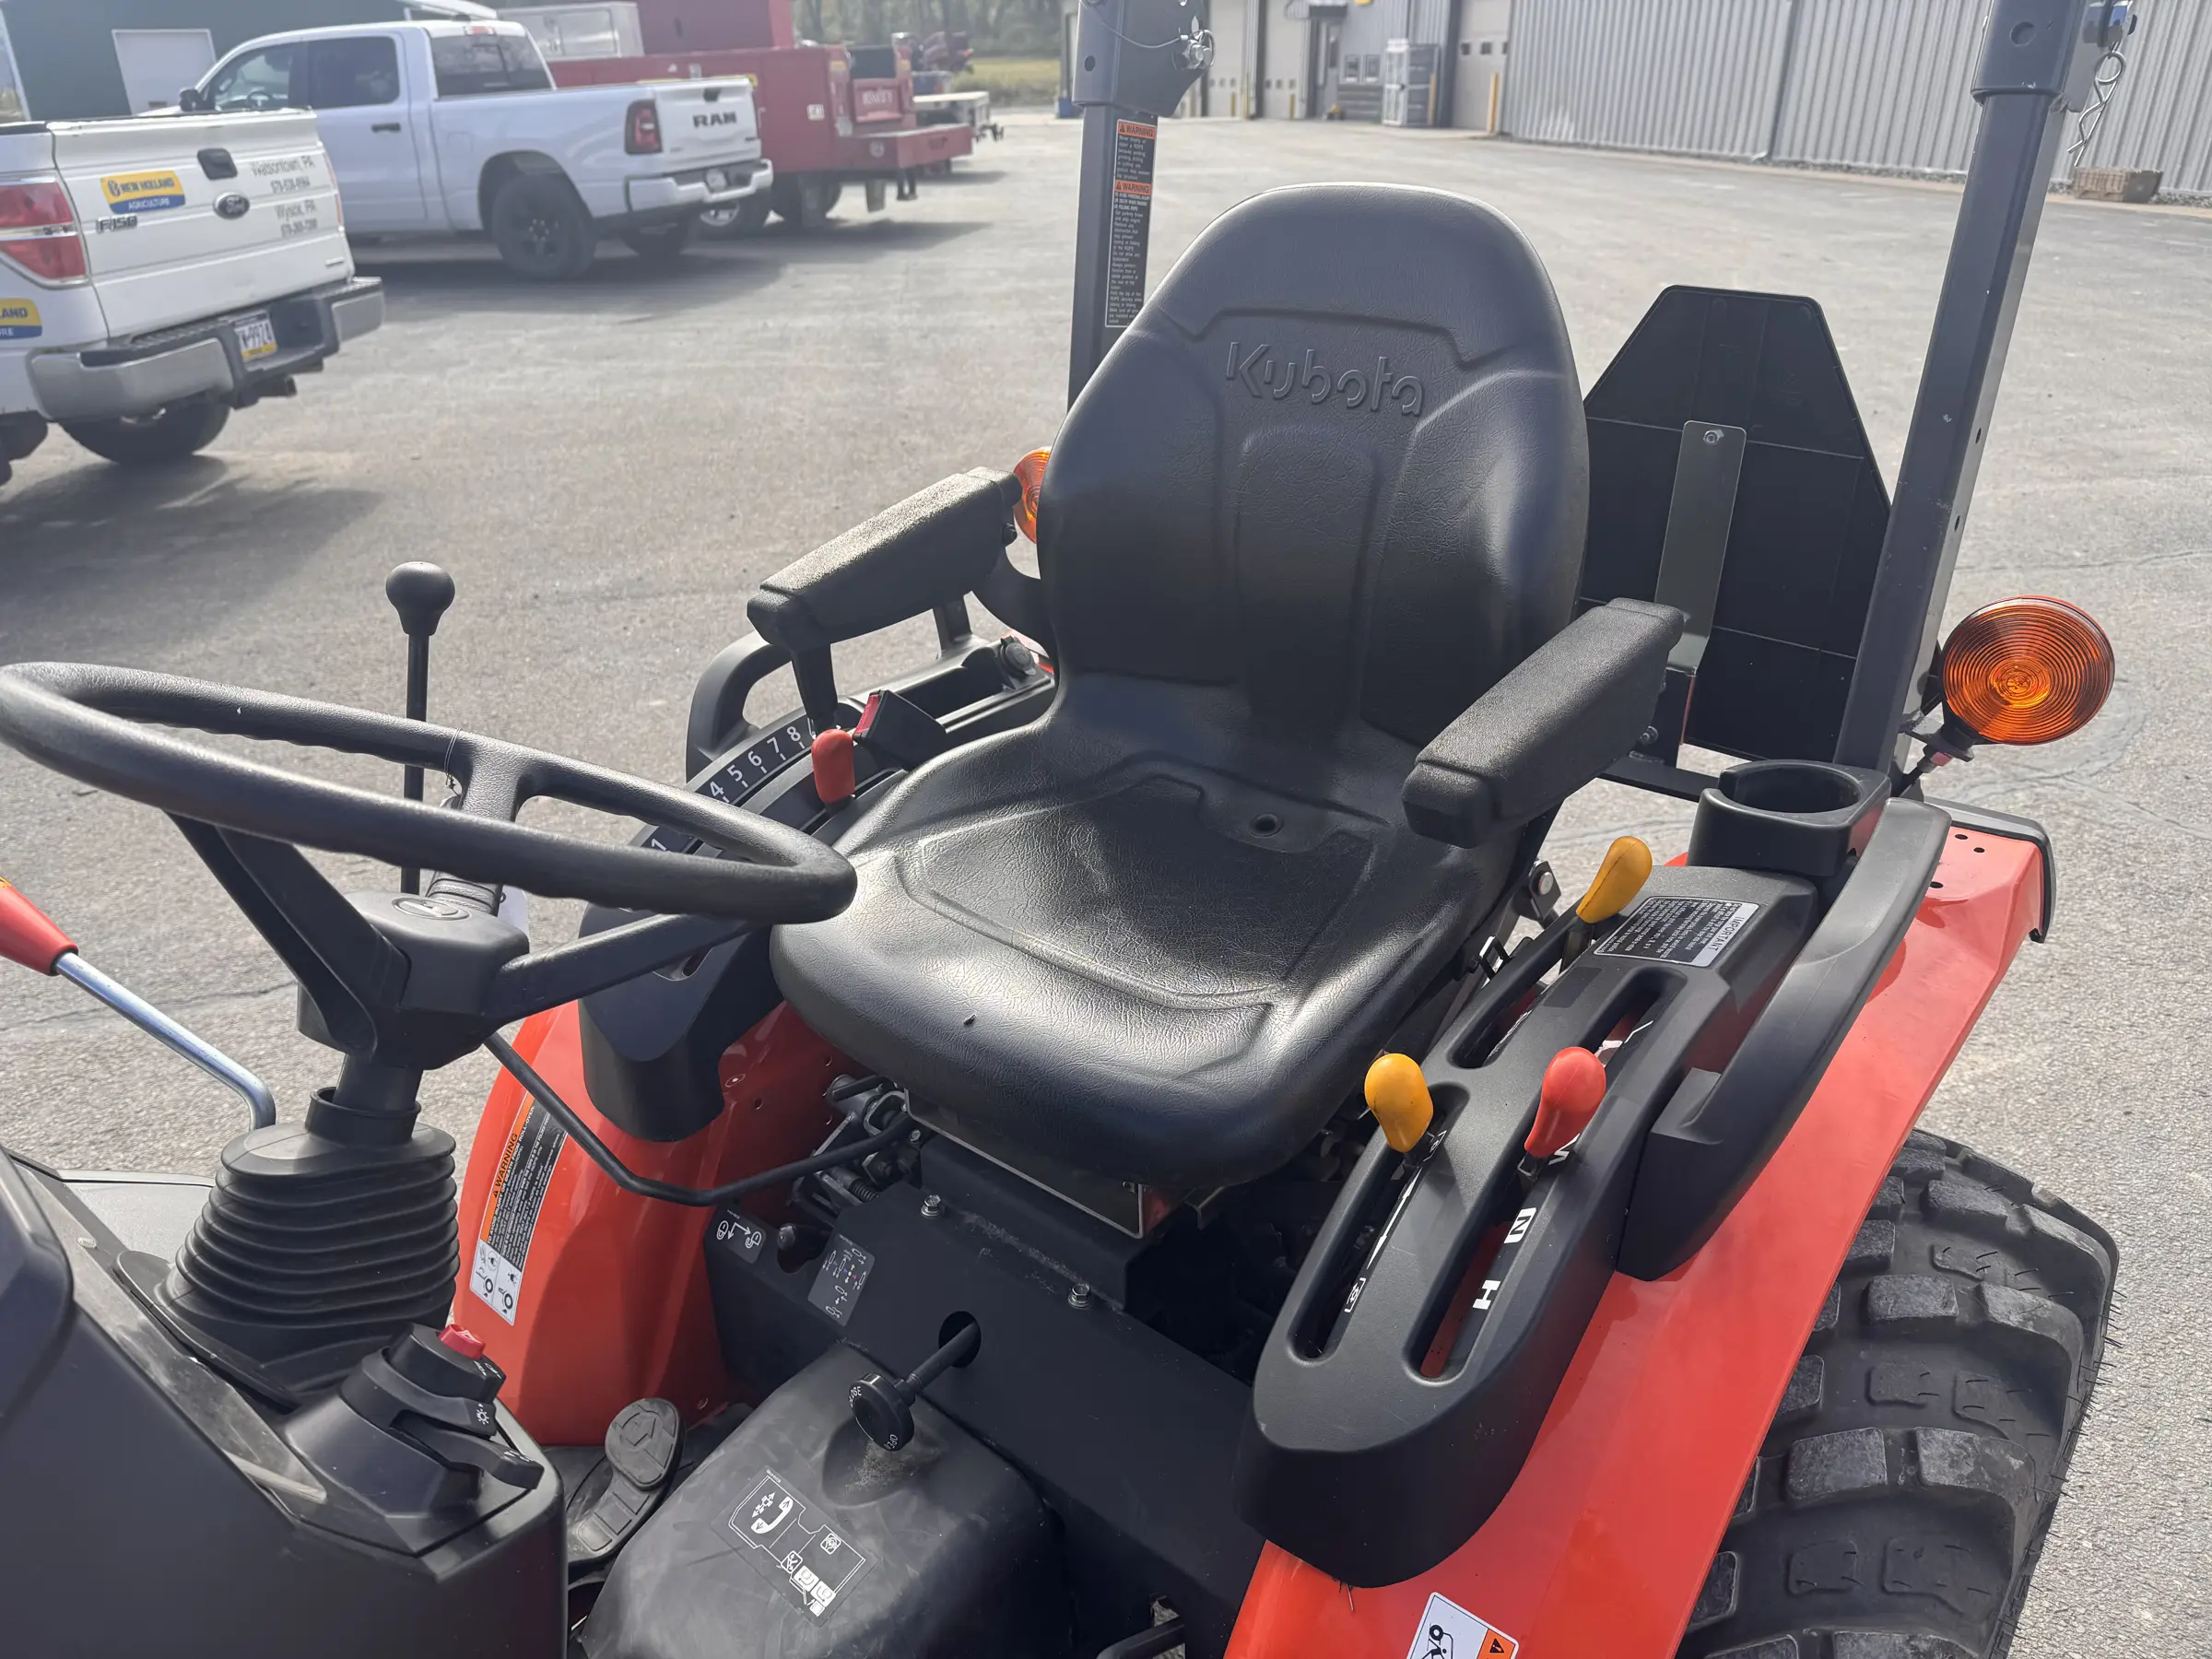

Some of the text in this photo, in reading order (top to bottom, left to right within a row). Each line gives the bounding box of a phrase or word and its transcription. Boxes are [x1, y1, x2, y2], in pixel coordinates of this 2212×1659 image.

[693, 111, 736, 128] RAM
[1126, 125, 1154, 137] WARNING
[1122, 182, 1150, 194] WARNING
[1226, 341, 1424, 416] Kubota
[709, 726, 801, 796] 4 5 6 7 8
[1709, 916, 1745, 951] IMPORTANT
[495, 1132, 517, 1188] WARNING
[1510, 1216, 1530, 1235] N
[1473, 1280, 1500, 1310] H
